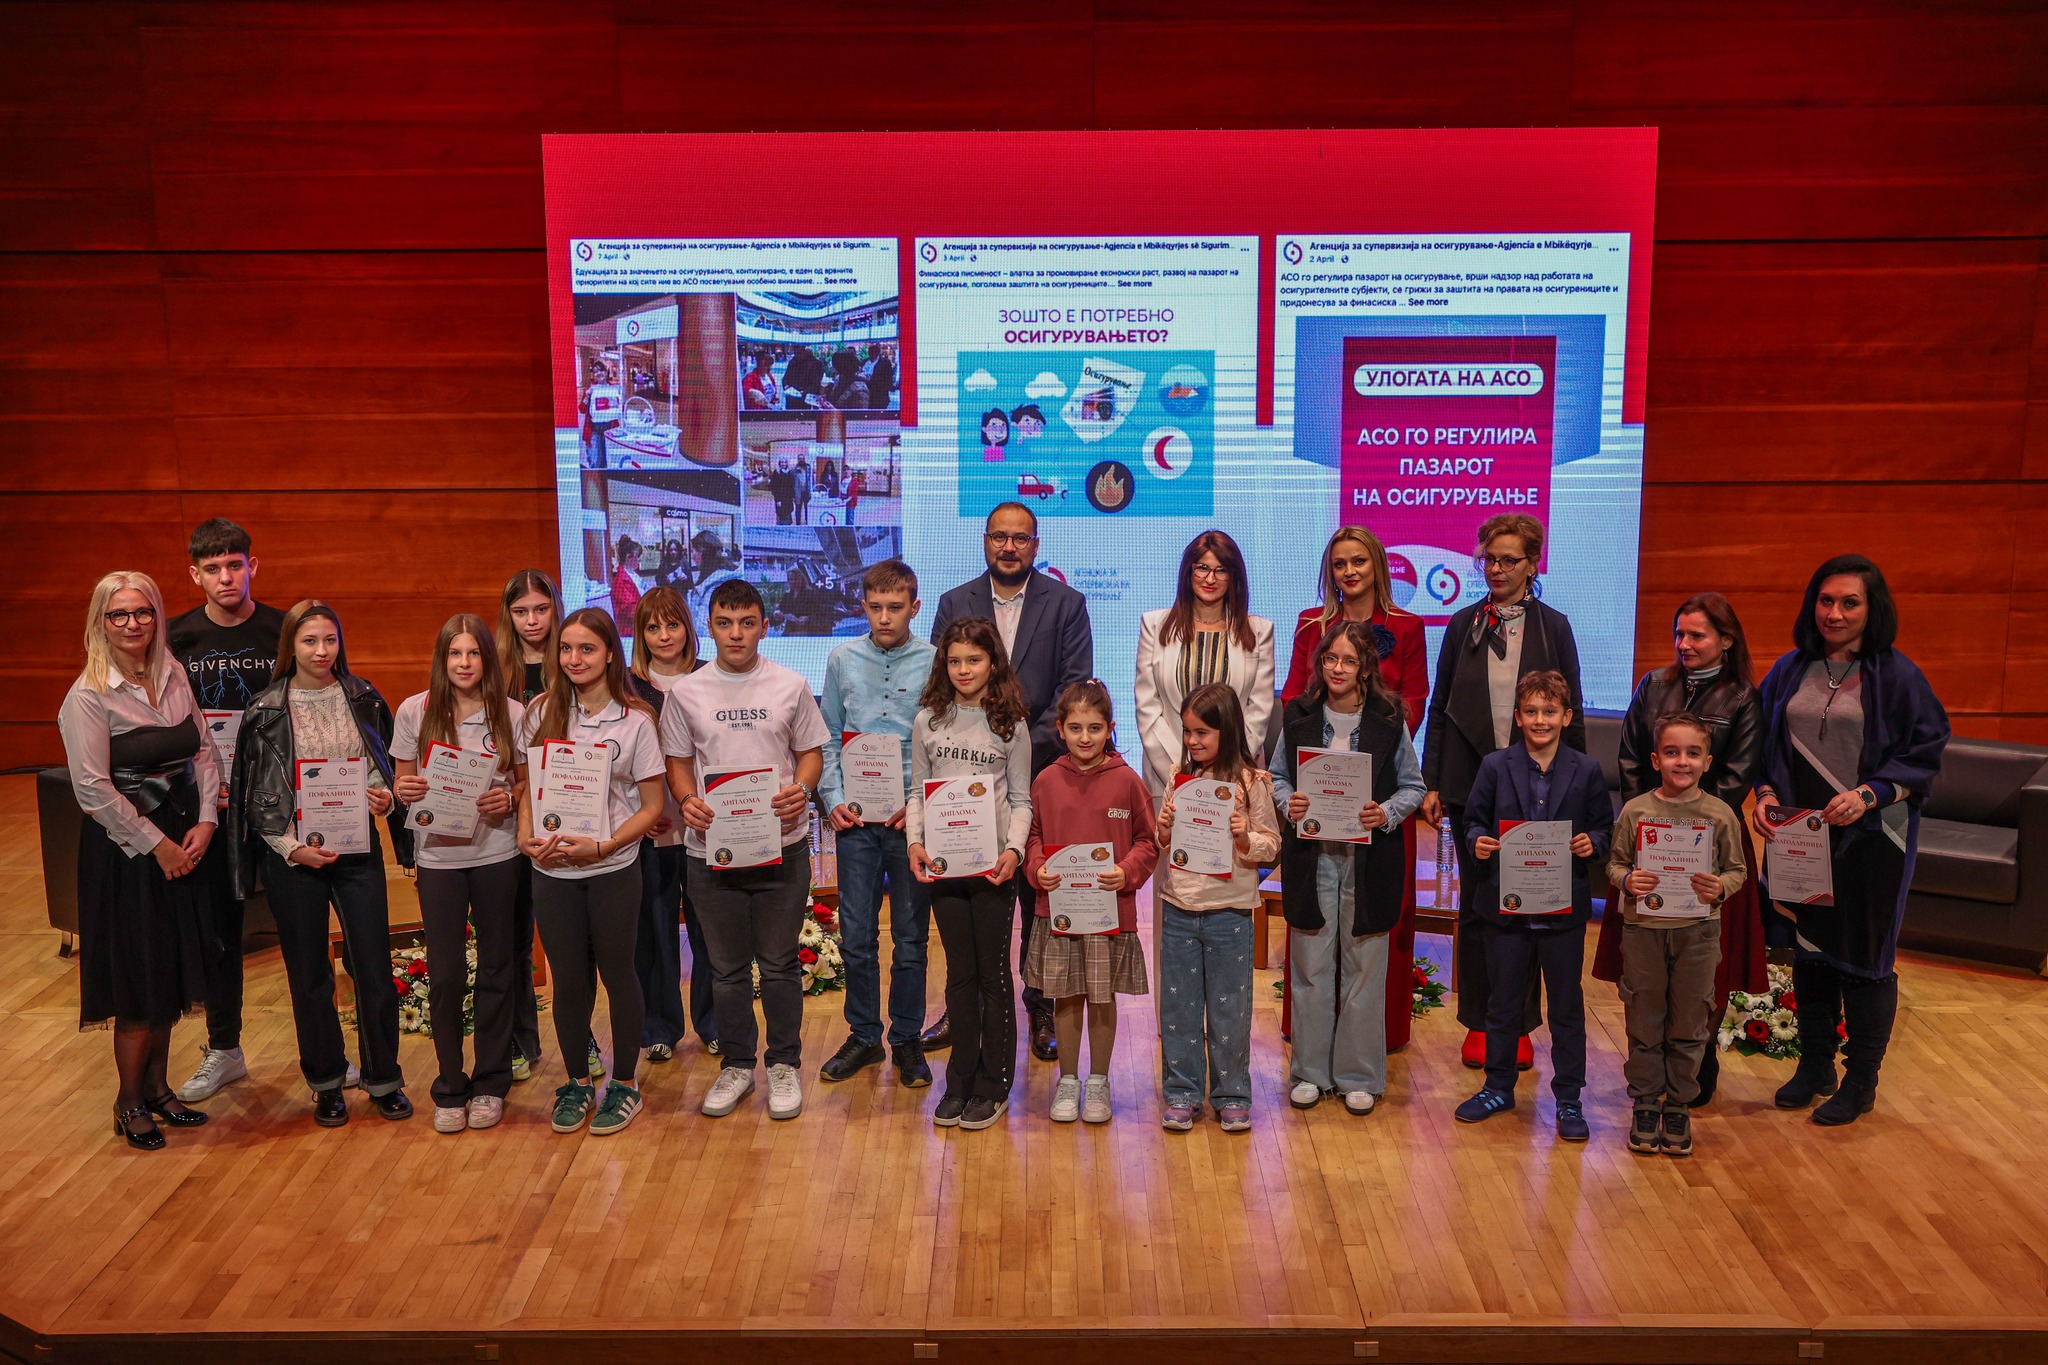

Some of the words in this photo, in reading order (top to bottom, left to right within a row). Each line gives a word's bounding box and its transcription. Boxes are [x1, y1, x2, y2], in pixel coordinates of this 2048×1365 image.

[597, 243, 630, 251] Агенција
[642, 242, 687, 252] супервизија
[943, 243, 977, 252] Агенција
[989, 243, 1037, 253] супервизија
[1310, 242, 1350, 251] Агенција
[1363, 241, 1419, 252] супервизија
[1317, 255, 1334, 264] April
[1281, 273, 1299, 281] АСО
[1313, 274, 1353, 283] регулира
[1355, 273, 1389, 282] пазарот
[1404, 273, 1463, 283] осигурување,
[1465, 273, 1489, 281] врши
[1491, 273, 1522, 281] надзор
[1524, 272, 1540, 281] над
[1541, 271, 1581, 281] работата
[1582, 272, 1593, 280] на
[1280, 286, 1349, 295] осигурителните
[1351, 285, 1390, 295] субјекти,
[1404, 286, 1432, 294] грижи
[1445, 285, 1481, 293] заштита
[1483, 285, 1494, 293] на
[1496, 285, 1531, 294] правата
[1545, 285, 1611, 294] осигурениците
[1280, 299, 1336, 308] придонесува
[1408, 298, 1425, 306] See
[999, 309, 1062, 323] ЗОШТО
[1066, 309, 1076, 322] Е
[1081, 308, 1174, 323] ПОТРЕБНО
[1004, 329, 1168, 344] ОСИГУРУВАЊЕТО?
[1367, 370, 1452, 387] УЛОГАТА
[1458, 370, 1485, 386] НА
[1491, 369, 1531, 386] АСО
[1357, 428, 1399, 445] АСО
[1405, 428, 1429, 445] ГО
[1434, 427, 1537, 446] РЕГУЛИРА
[1400, 458, 1494, 475] ПАЗАРОТ
[1353, 488, 1381, 506] НА
[1386, 488, 1538, 506] ОСИГУРУВАЊЕ
[814, 577, 834, 590] +5
[189, 658, 277, 674] GIVENCHY
[715, 708, 768, 722] GUESS
[936, 746, 997, 765] SPARKLE
[853, 760, 889, 769] ДИПЛОМА
[432, 773, 478, 788] ПОФАЛНИЦА
[551, 772, 598, 783] ПОФАЛНИЦА
[1313, 778, 1353, 788] ДИПЛОМА
[308, 789, 356, 798] ПОФАЛНИЦА
[721, 796, 761, 807] ДИПЛОМА
[939, 808, 977, 818] ДИПЛОМА
[1107, 810, 1130, 820] GROW
[1184, 805, 1221, 817] ДИПЛОМА
[1774, 837, 1824, 849] ЛАГОДАРНИЦА
[1514, 849, 1557, 858] ДИПЛОМА
[1649, 853, 1700, 864] ПОФАЛНИЦА
